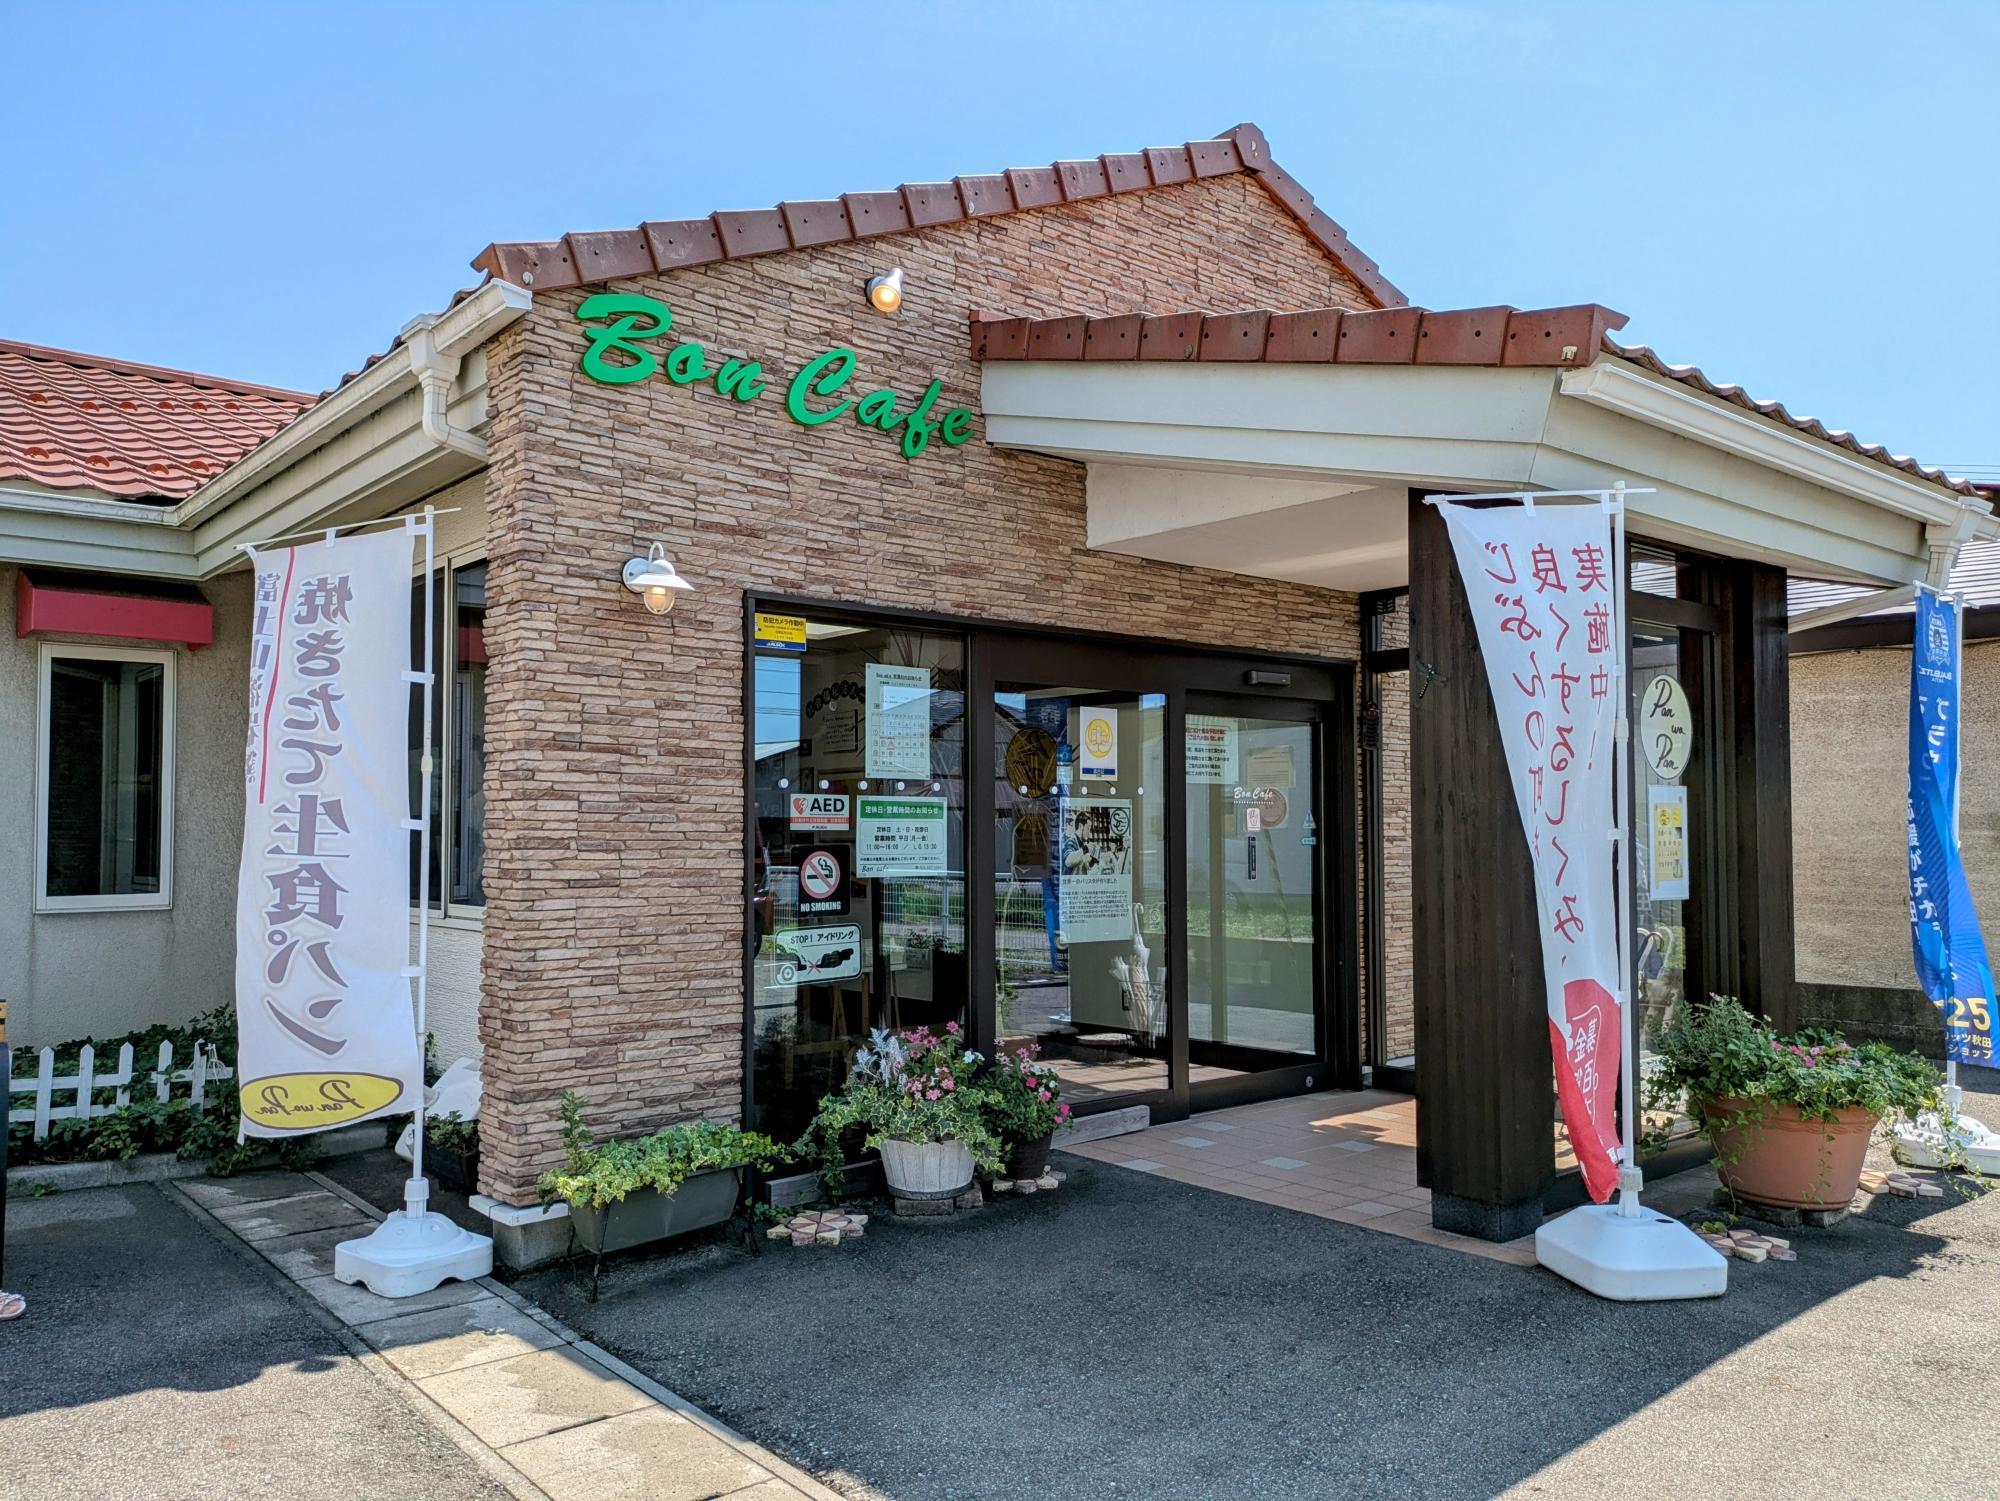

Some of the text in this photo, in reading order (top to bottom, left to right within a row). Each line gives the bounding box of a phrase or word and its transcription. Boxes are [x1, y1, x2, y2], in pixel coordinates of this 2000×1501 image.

[575, 293, 975, 459] Bon Cafe
[1649, 677, 1675, 719] Pan
[1655, 733, 1679, 770] Pan
[1233, 786, 1273, 800] Bon Cafe
[809, 797, 845, 813] AED
[800, 900, 842, 913] NO SMOKING
[817, 930, 854, 942] アイドリング
[1948, 1044, 1993, 1060] ショップ
